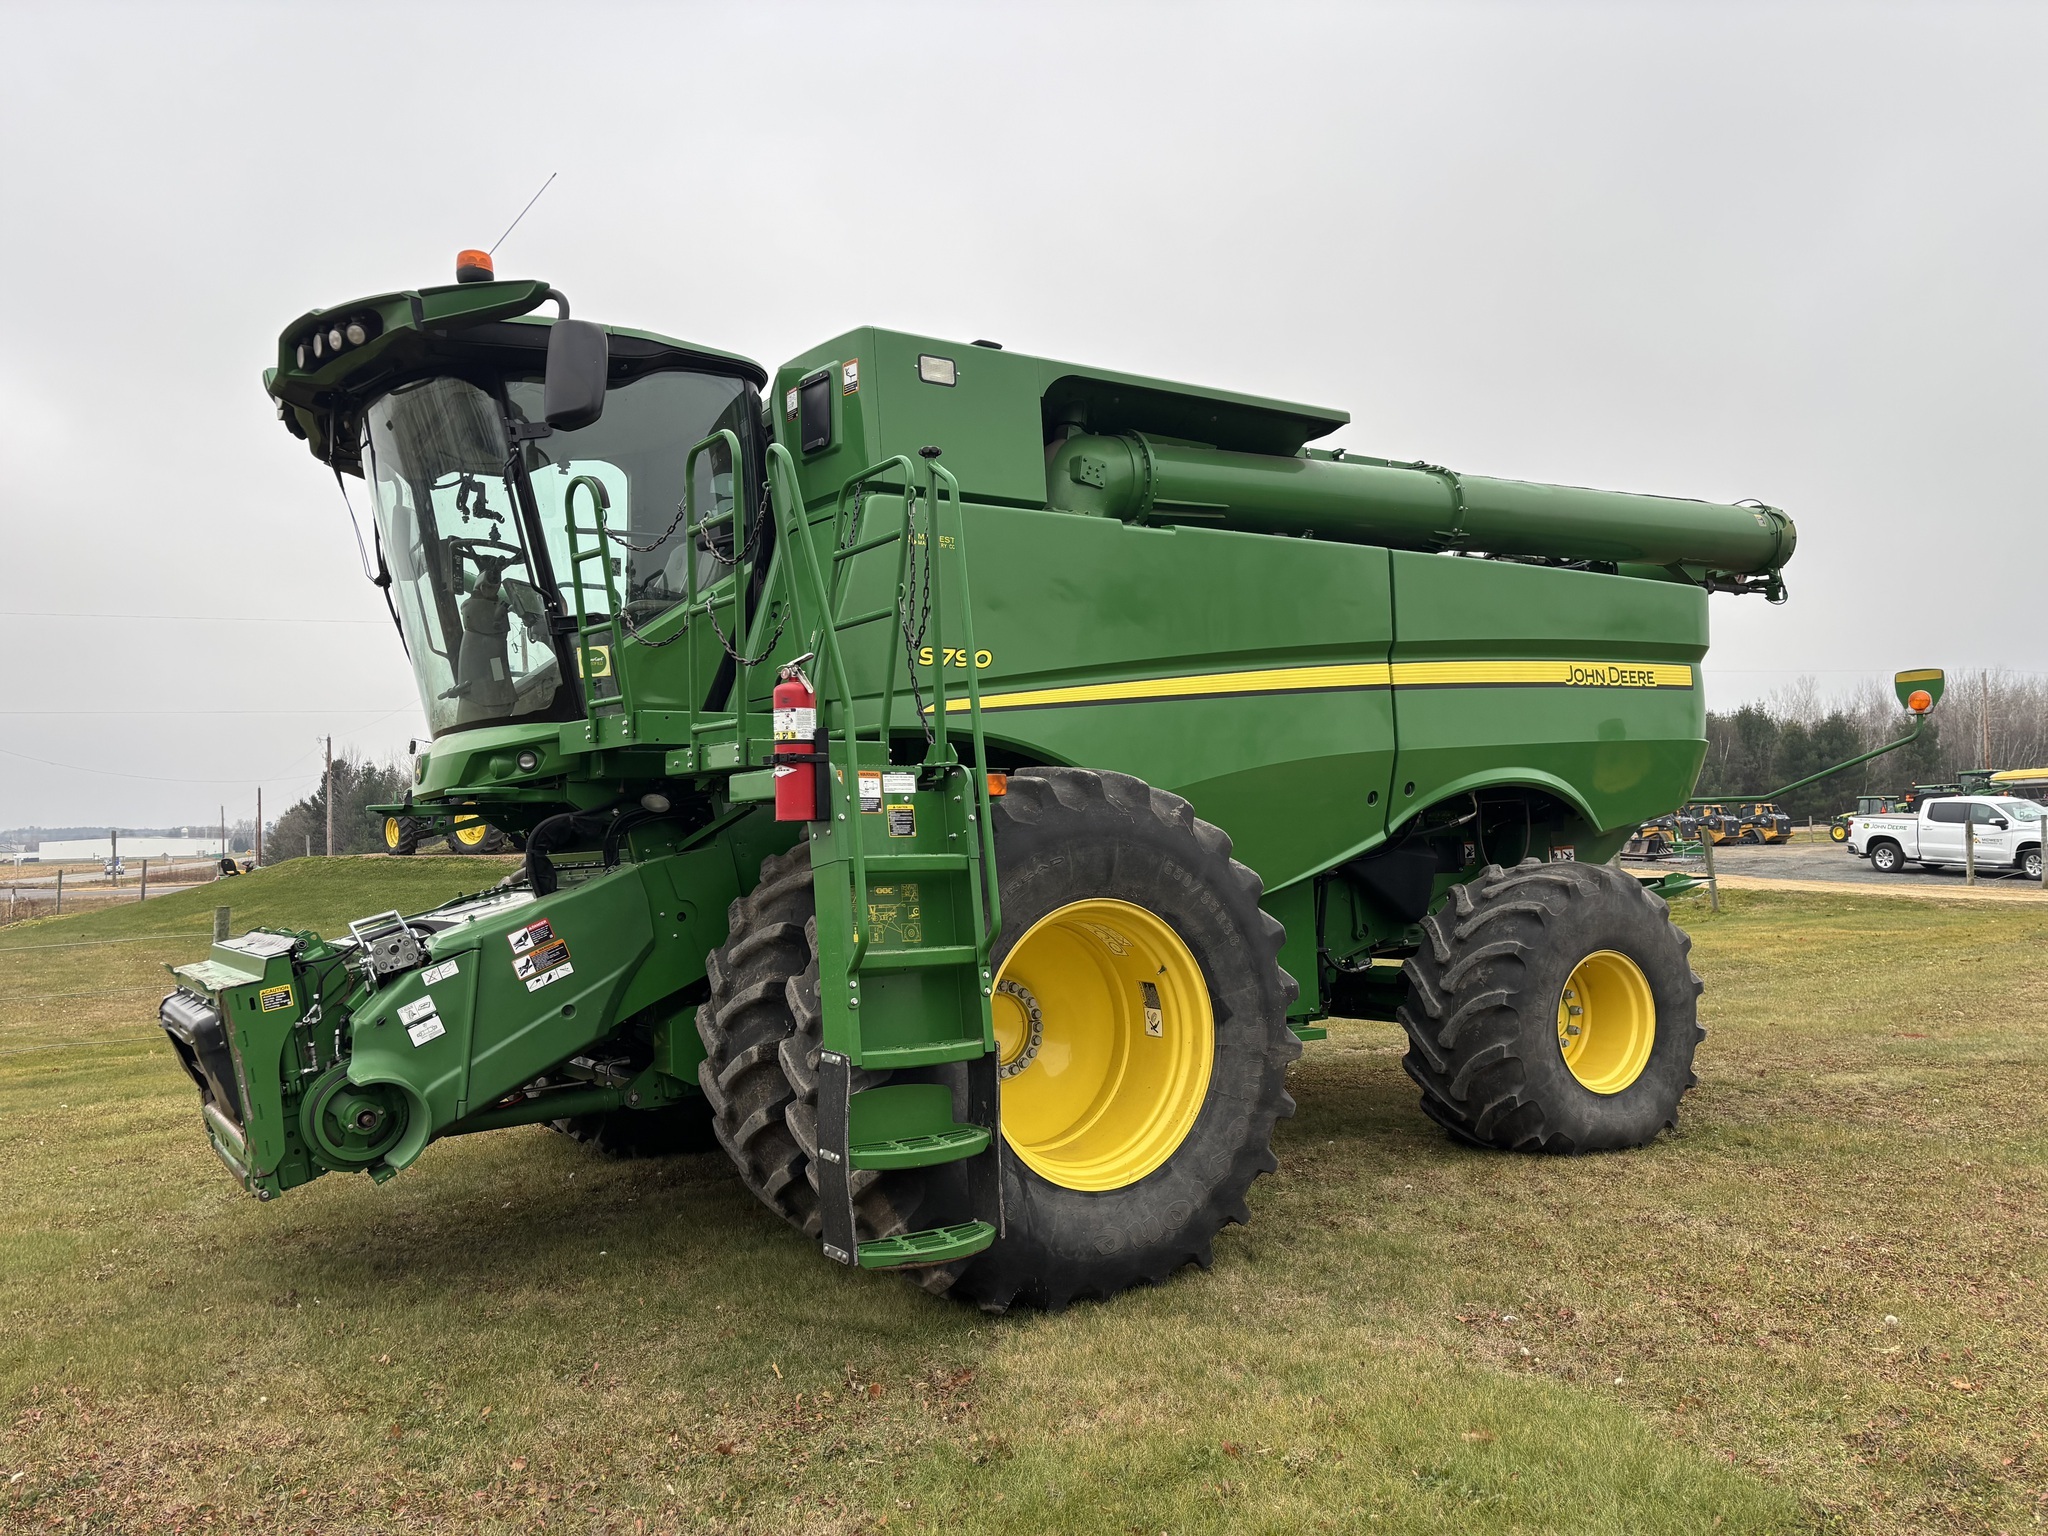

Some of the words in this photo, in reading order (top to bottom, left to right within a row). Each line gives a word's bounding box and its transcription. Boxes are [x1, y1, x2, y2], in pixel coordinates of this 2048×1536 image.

[918, 647, 993, 669] S790
[1565, 665, 1606, 684] JOHN
[1608, 666, 1656, 685] DEERE
[265, 985, 289, 995] CAUTION
